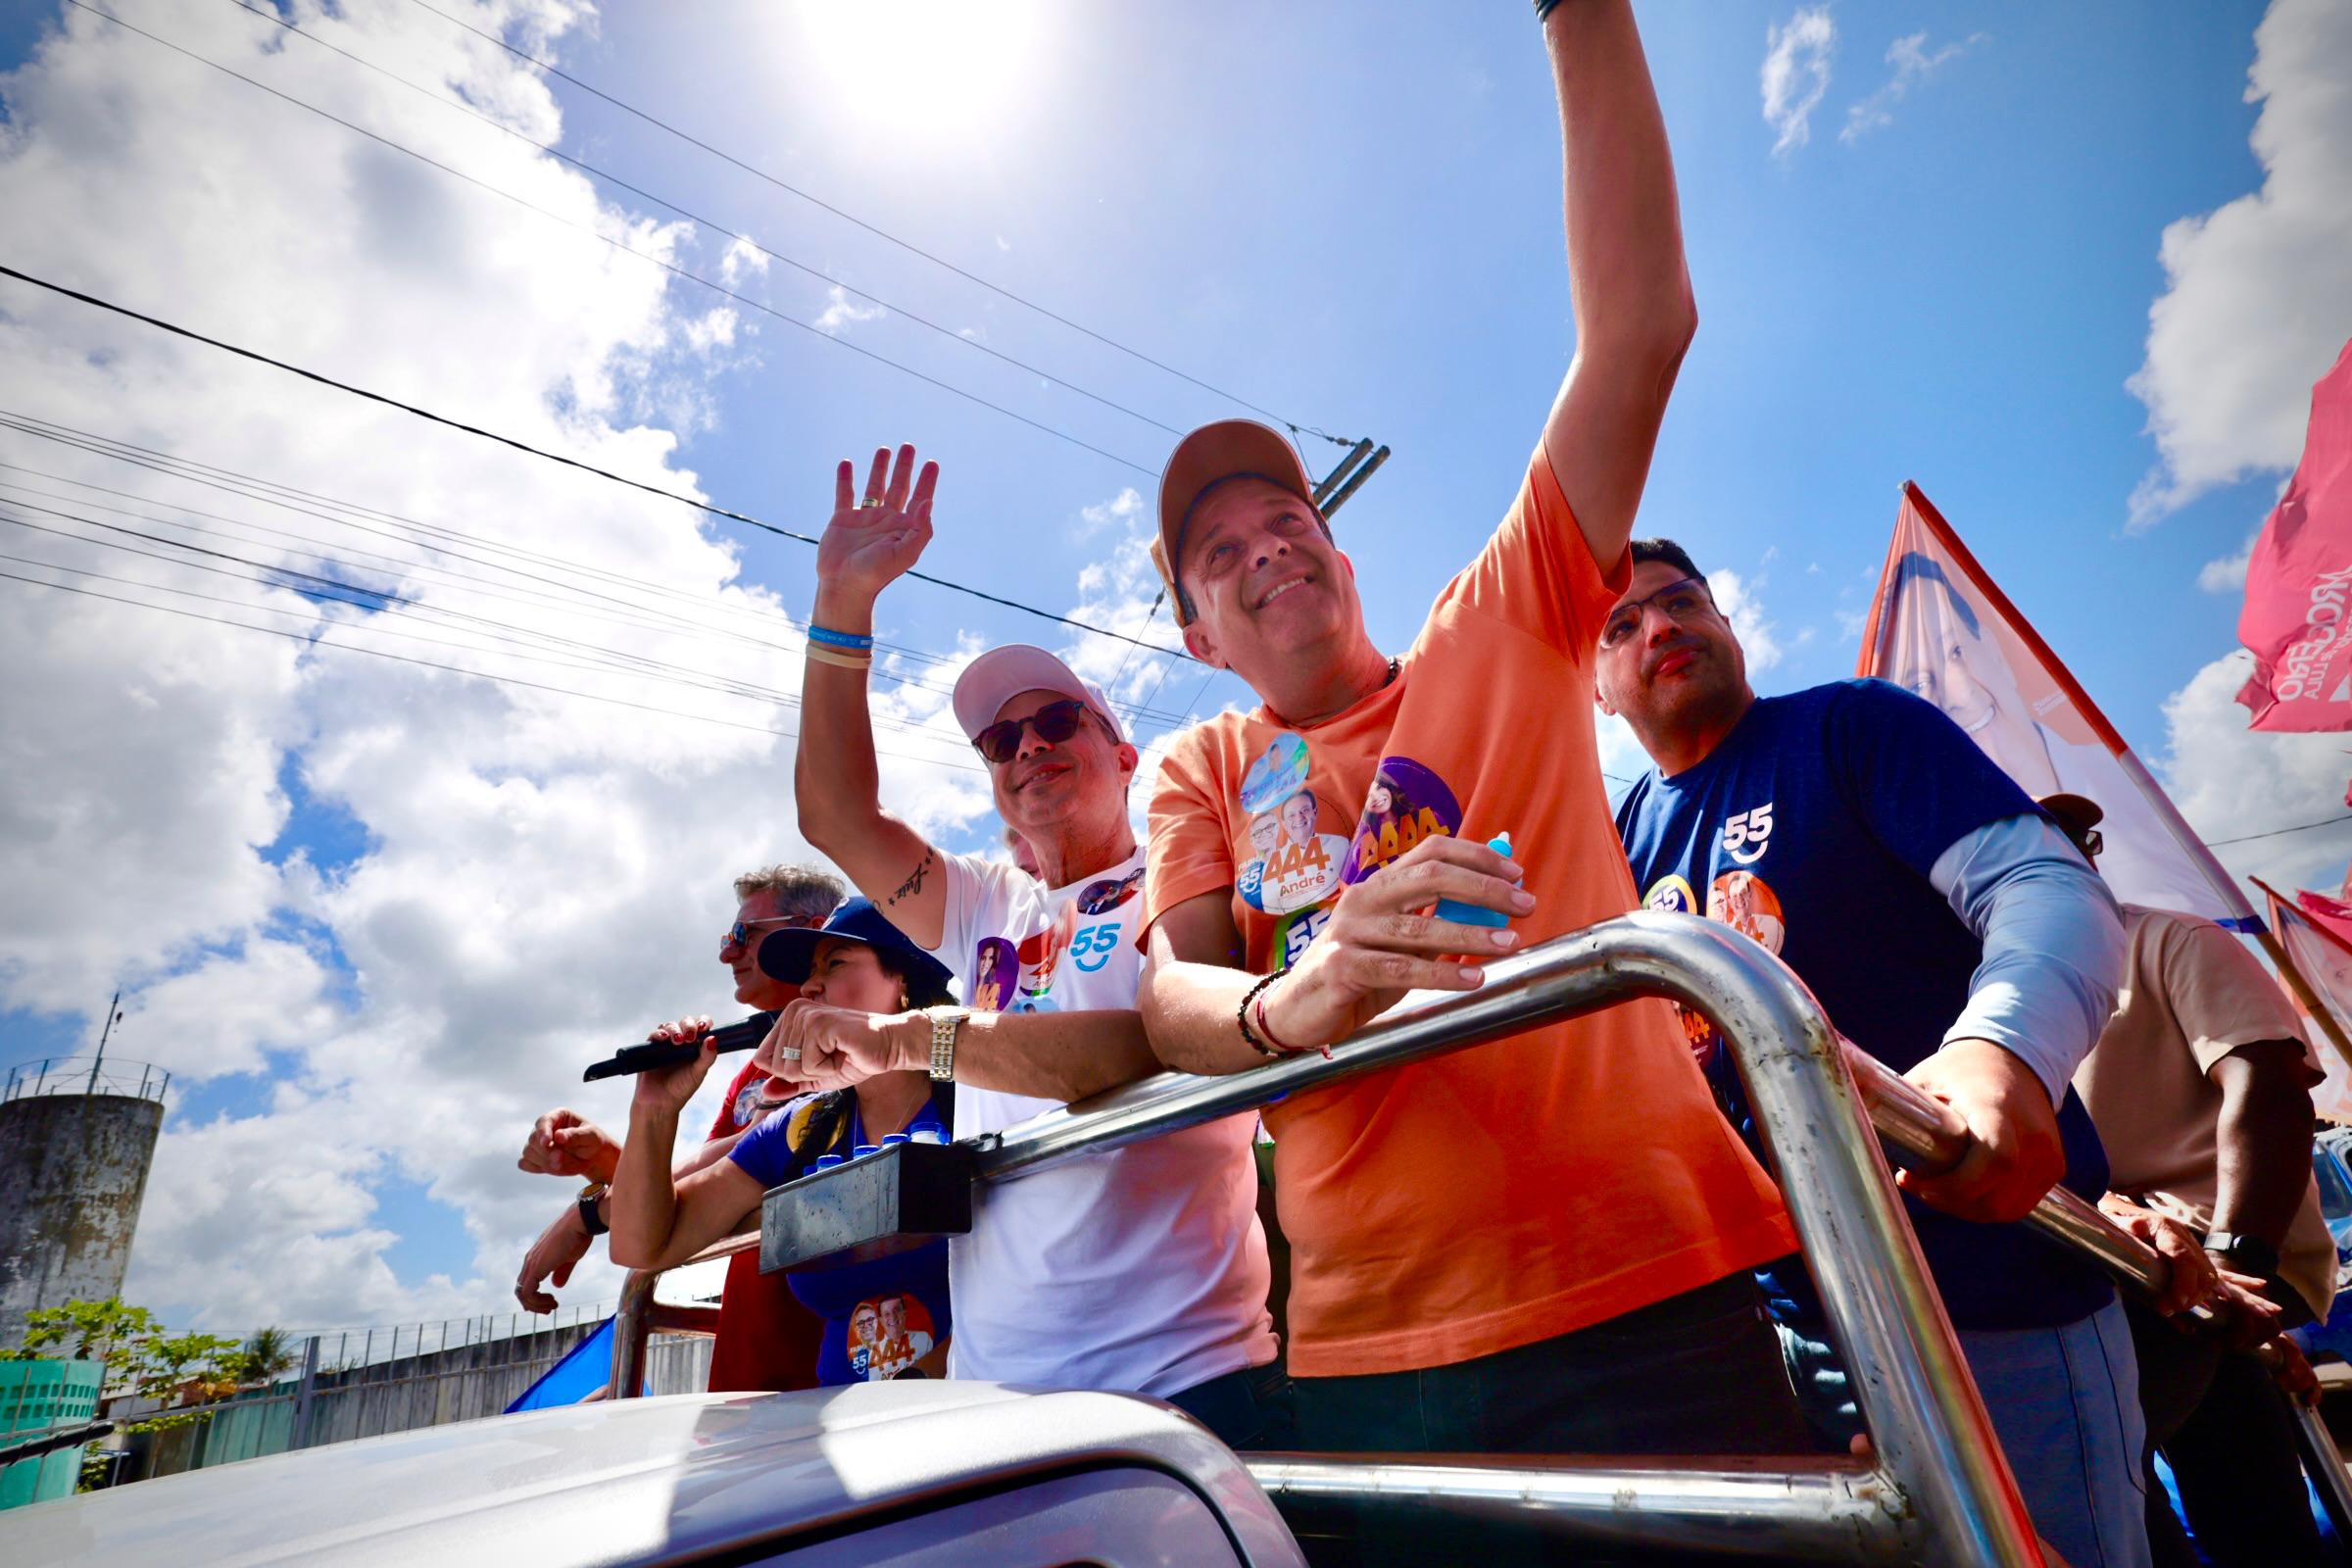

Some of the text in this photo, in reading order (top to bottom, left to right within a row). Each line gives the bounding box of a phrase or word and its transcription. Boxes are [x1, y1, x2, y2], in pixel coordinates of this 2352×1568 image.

[1722, 802, 1774, 851] 55
[1262, 835, 1331, 884] 444
[1239, 867, 1260, 889] 55
[1279, 871, 1326, 897] André
[1648, 884, 1680, 911] 55
[1069, 922, 1122, 957] 55
[853, 1353, 867, 1370] 55
[868, 1333, 916, 1372] 444
